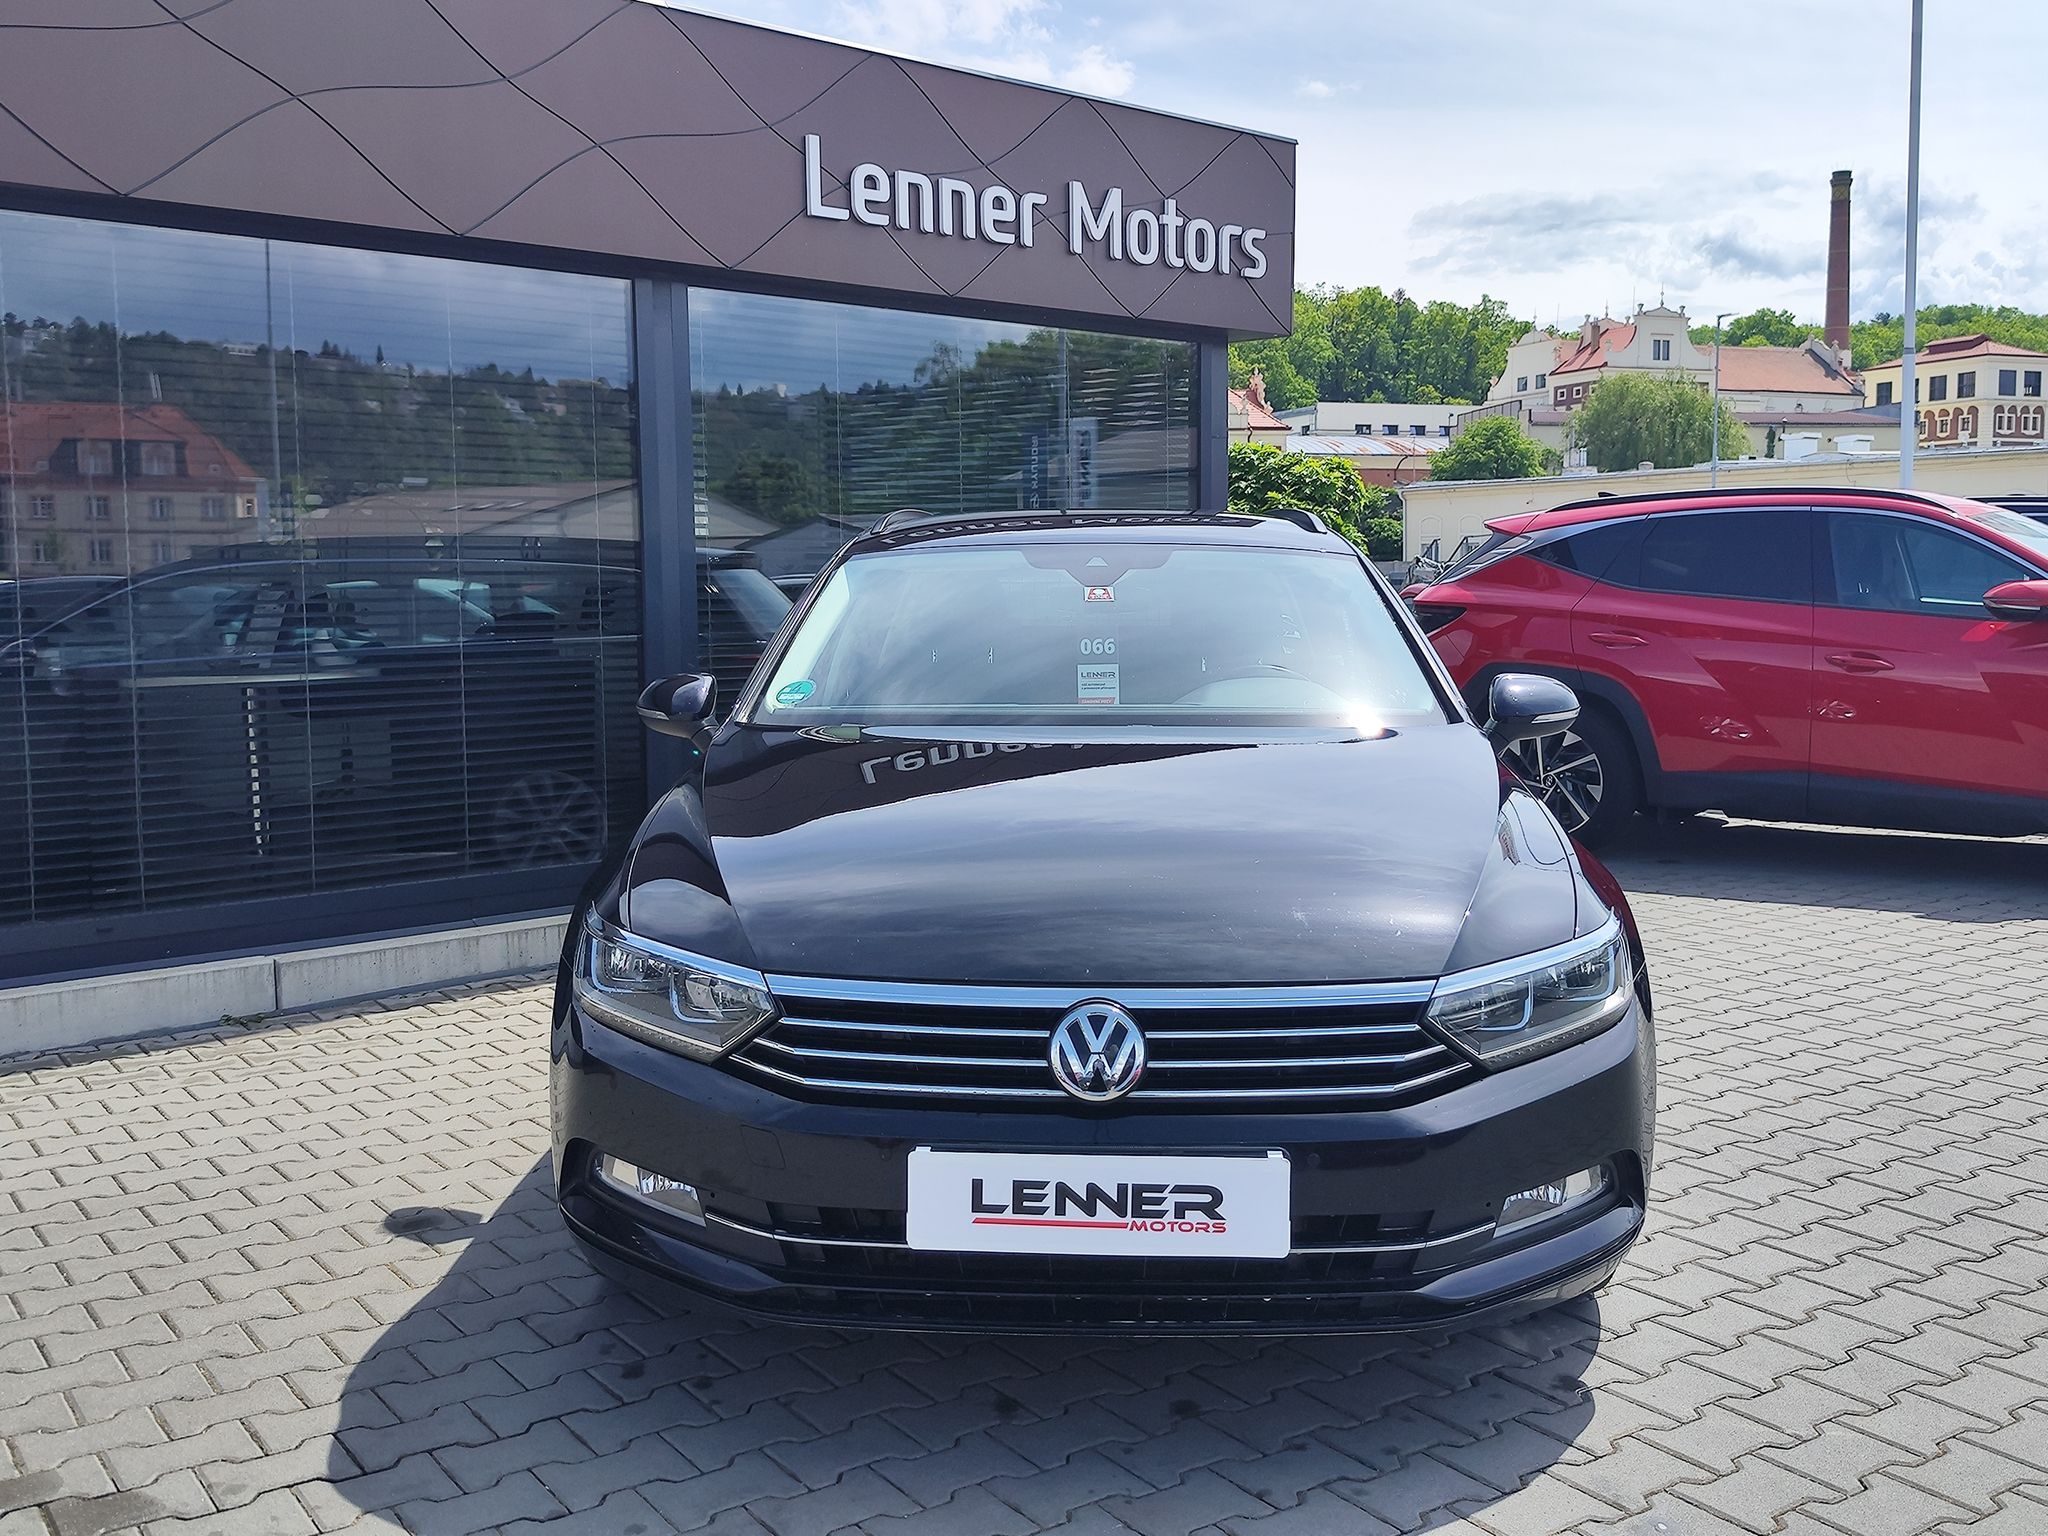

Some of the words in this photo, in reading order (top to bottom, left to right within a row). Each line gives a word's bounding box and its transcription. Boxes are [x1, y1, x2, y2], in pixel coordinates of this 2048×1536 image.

[804, 133, 1048, 248] Lenner
[1067, 180, 1268, 279] Motors
[1080, 638, 1116, 655] 066
[1080, 671, 1116, 679] LENNER
[971, 1178, 1226, 1220] LENNER
[1129, 1220, 1227, 1233] MOTORS
